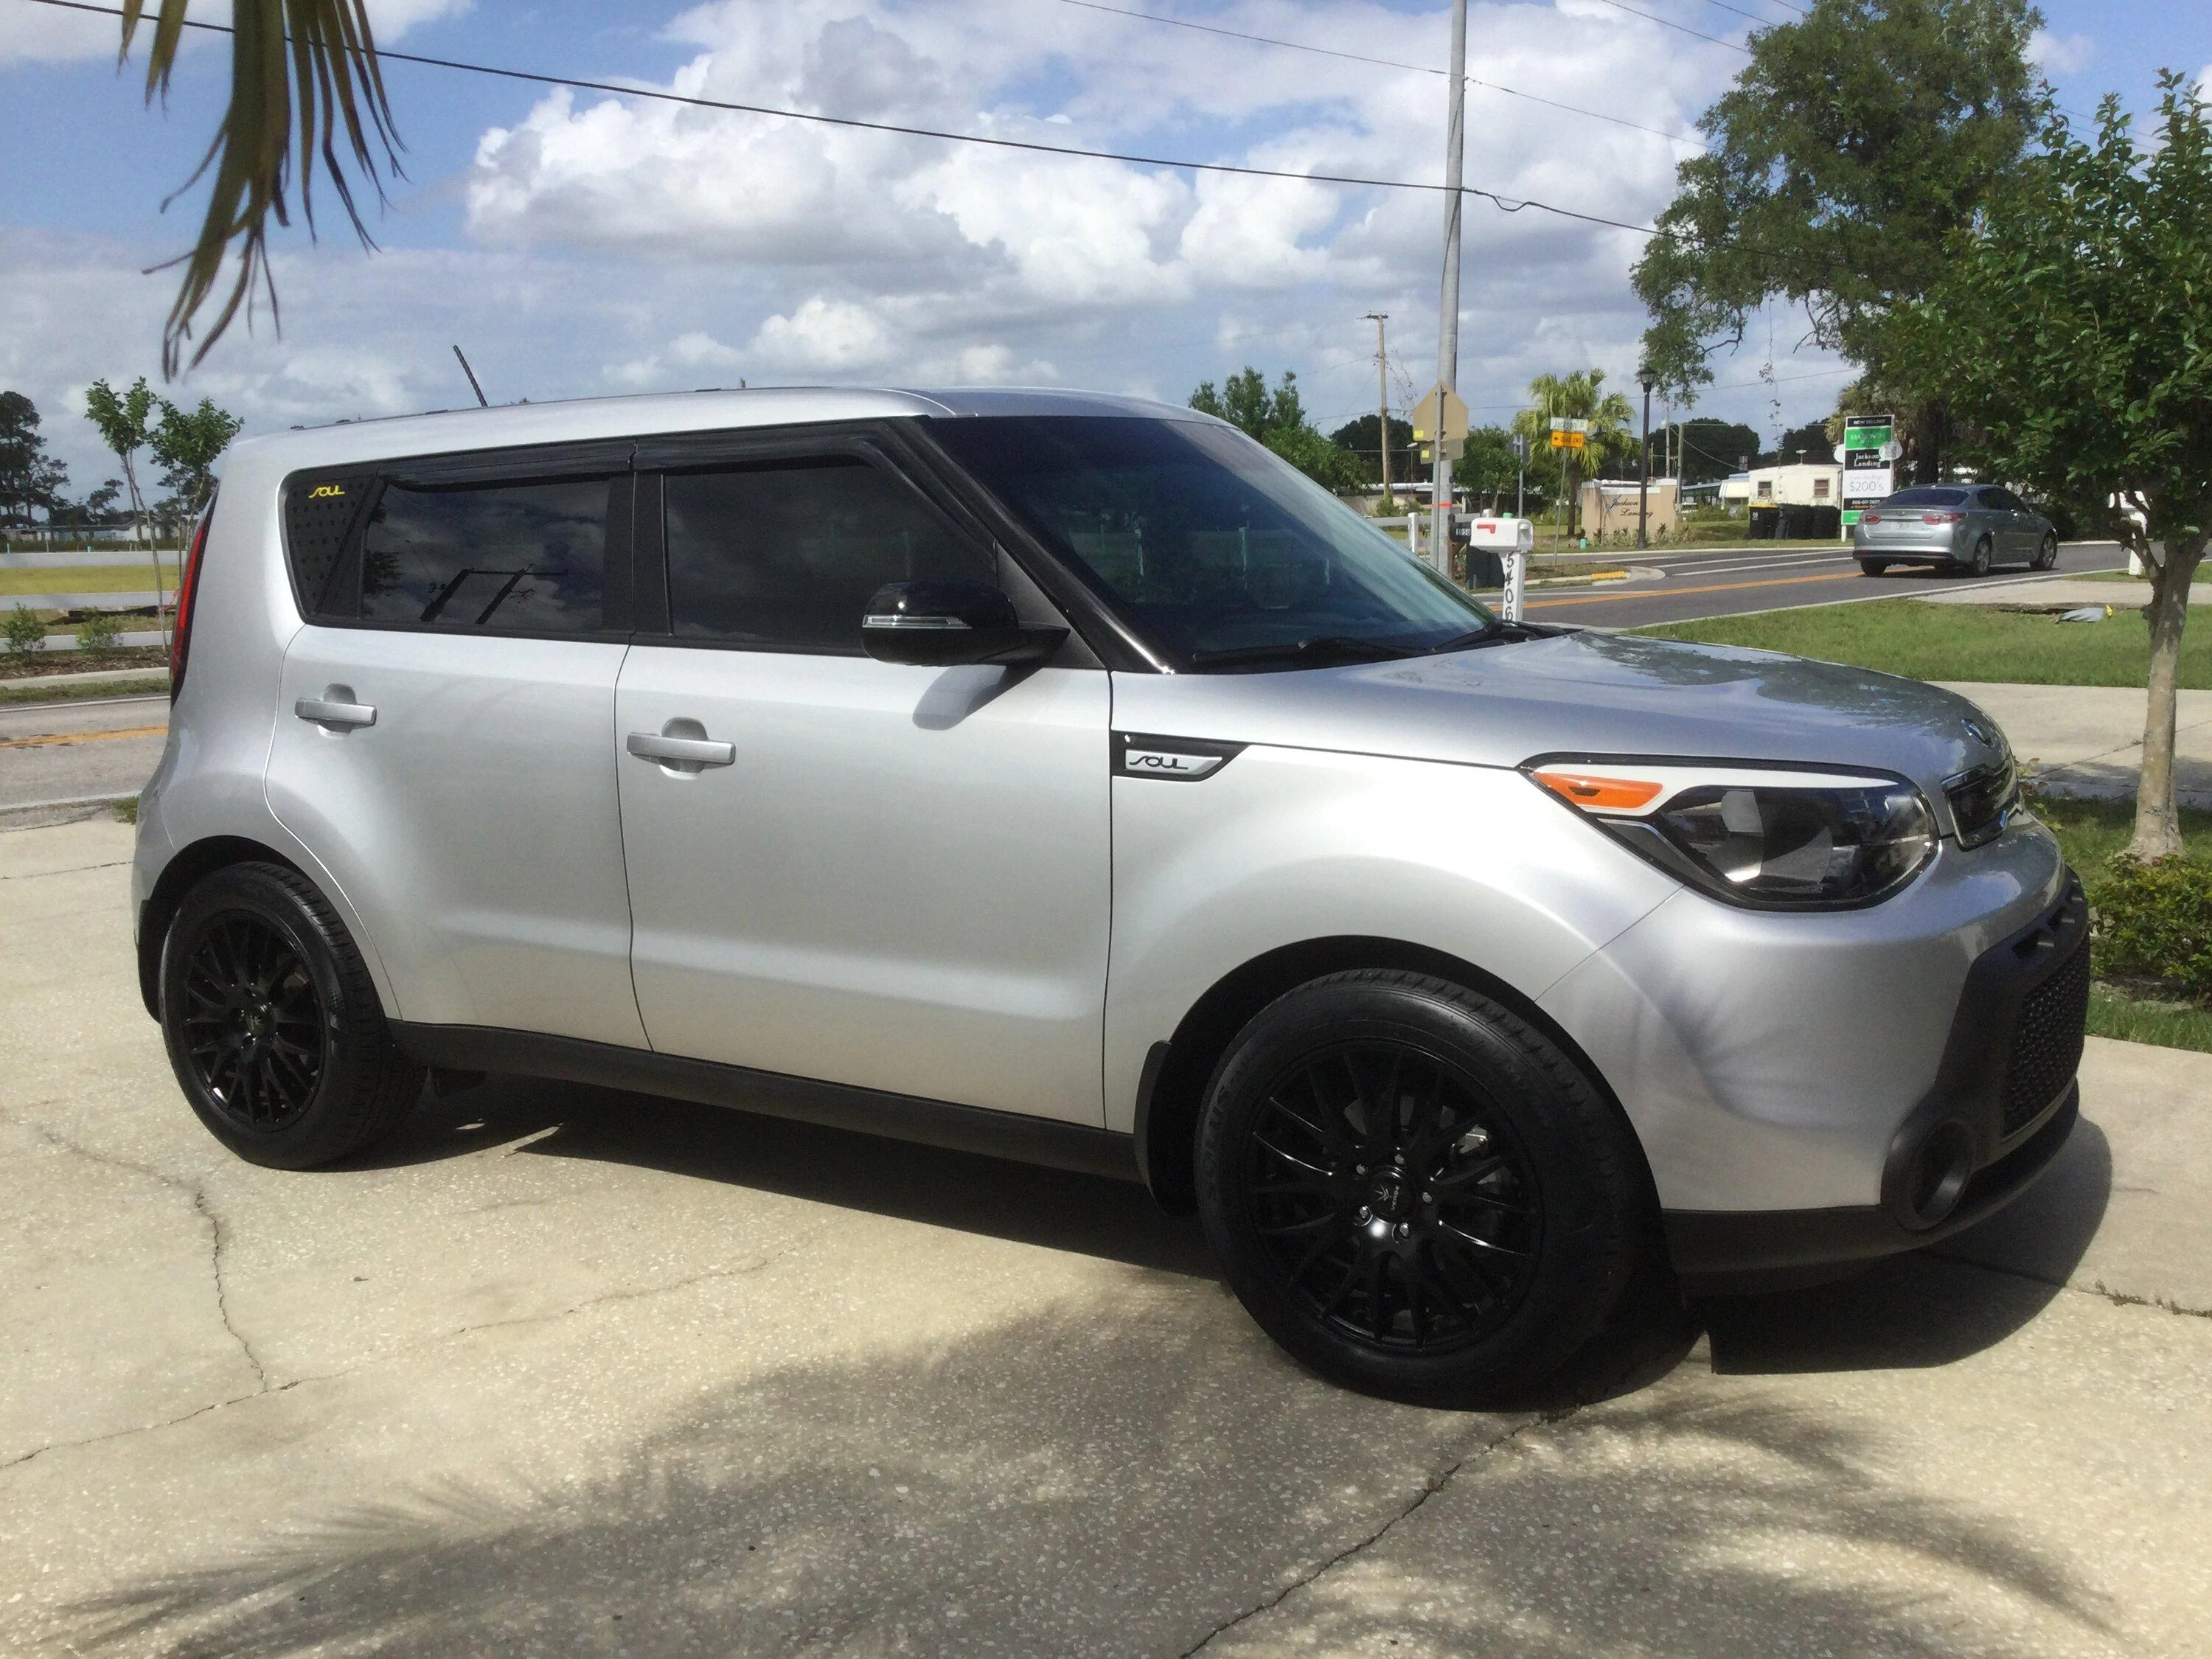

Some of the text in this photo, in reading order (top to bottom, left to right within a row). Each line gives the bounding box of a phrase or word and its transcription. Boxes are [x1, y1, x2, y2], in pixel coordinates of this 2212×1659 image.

[1855, 453, 1879, 461] Jackson
[309, 485, 345, 498] SOUL
[1849, 481, 1884, 492] $200's
[1505, 552, 1514, 621] 5406
[1129, 755, 1189, 770] SOUL
[1391, 1185, 1400, 1210] VERDE
